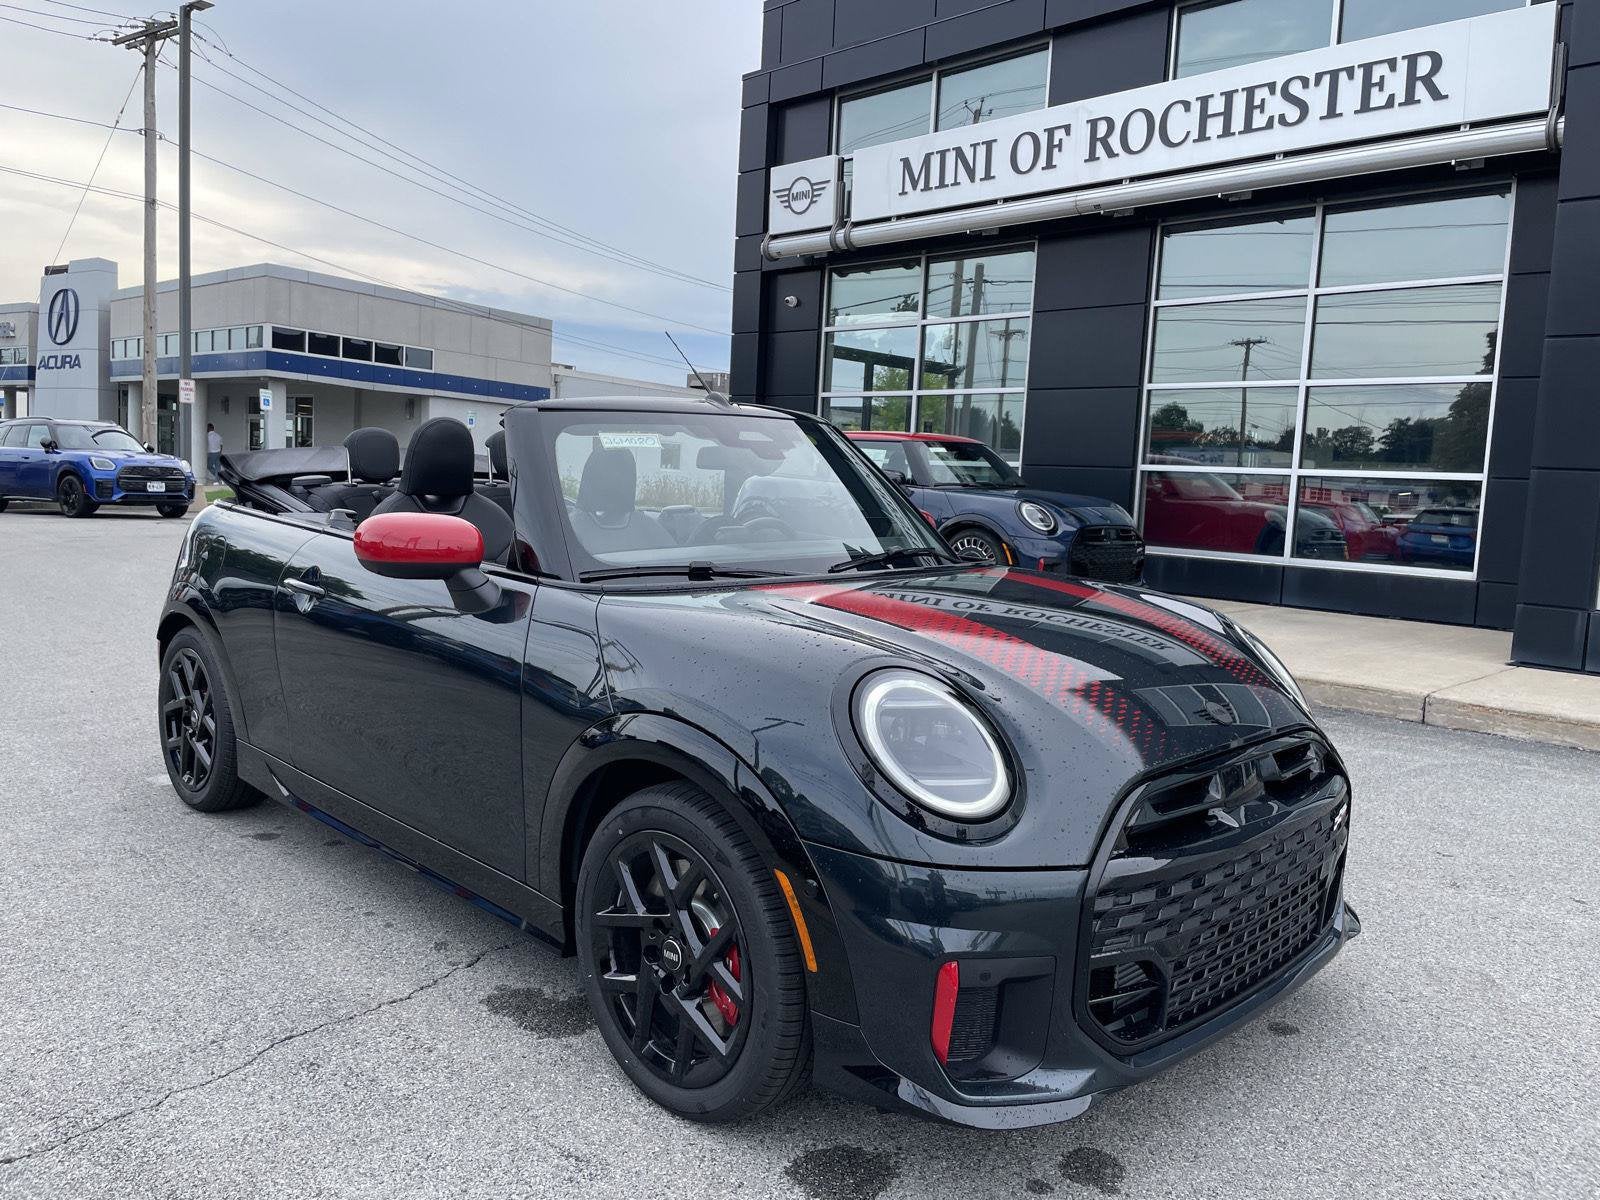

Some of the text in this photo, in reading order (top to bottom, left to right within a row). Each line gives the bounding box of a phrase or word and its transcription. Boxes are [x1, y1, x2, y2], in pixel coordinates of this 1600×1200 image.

[898, 50, 1449, 195] MINI OF ROCHESTER
[791, 190, 811, 202] MINI
[37, 354, 81, 370] ACURA
[663, 949, 679, 962] MINI
